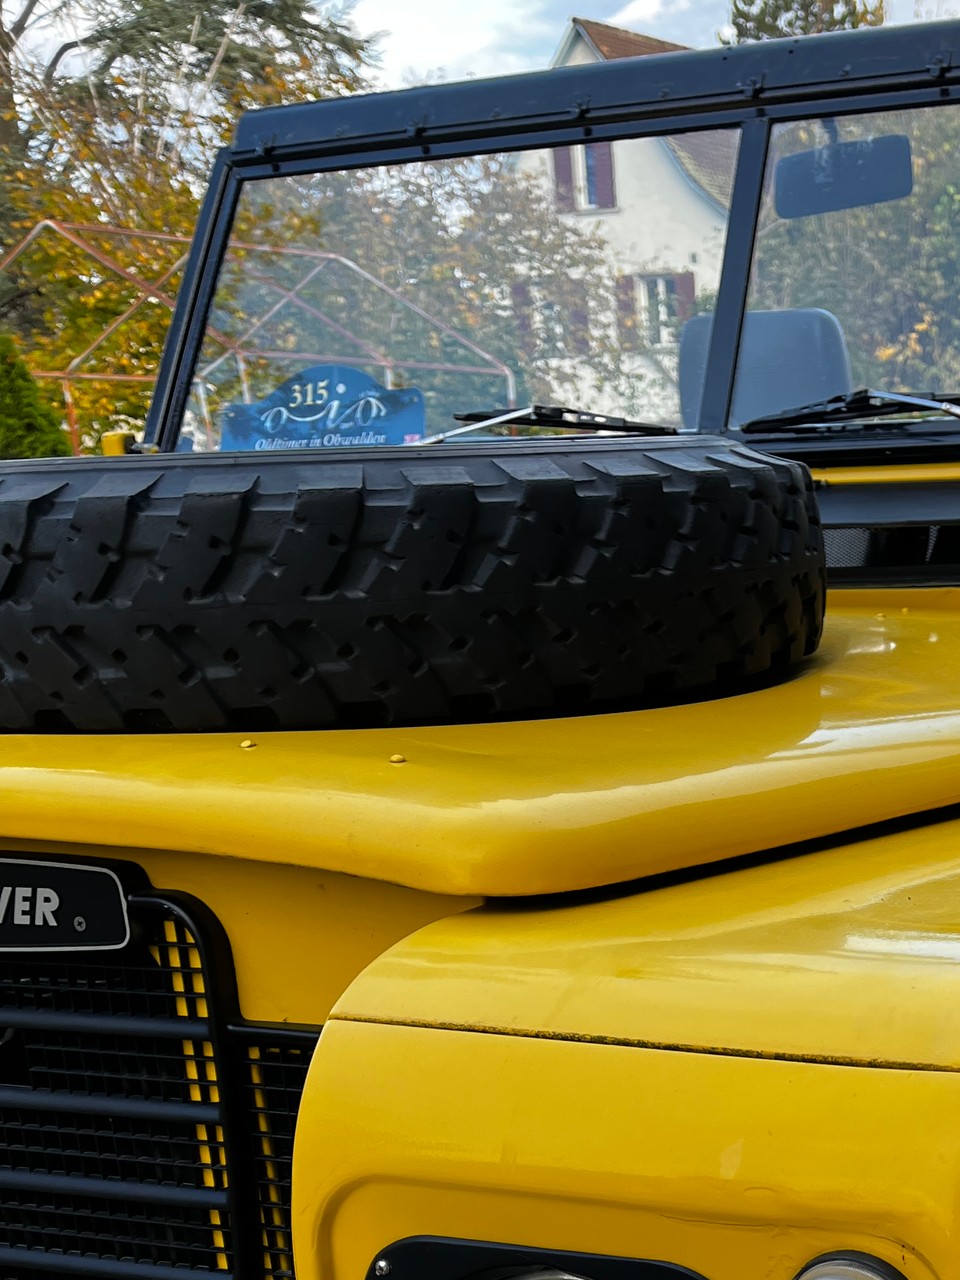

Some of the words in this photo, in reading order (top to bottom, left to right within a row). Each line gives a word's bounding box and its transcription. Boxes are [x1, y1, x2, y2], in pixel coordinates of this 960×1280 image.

[288, 378, 330, 408] 315
[254, 436, 307, 450] Oldtimer
[309, 436, 322, 448] in
[323, 430, 387, 446] Obwalden
